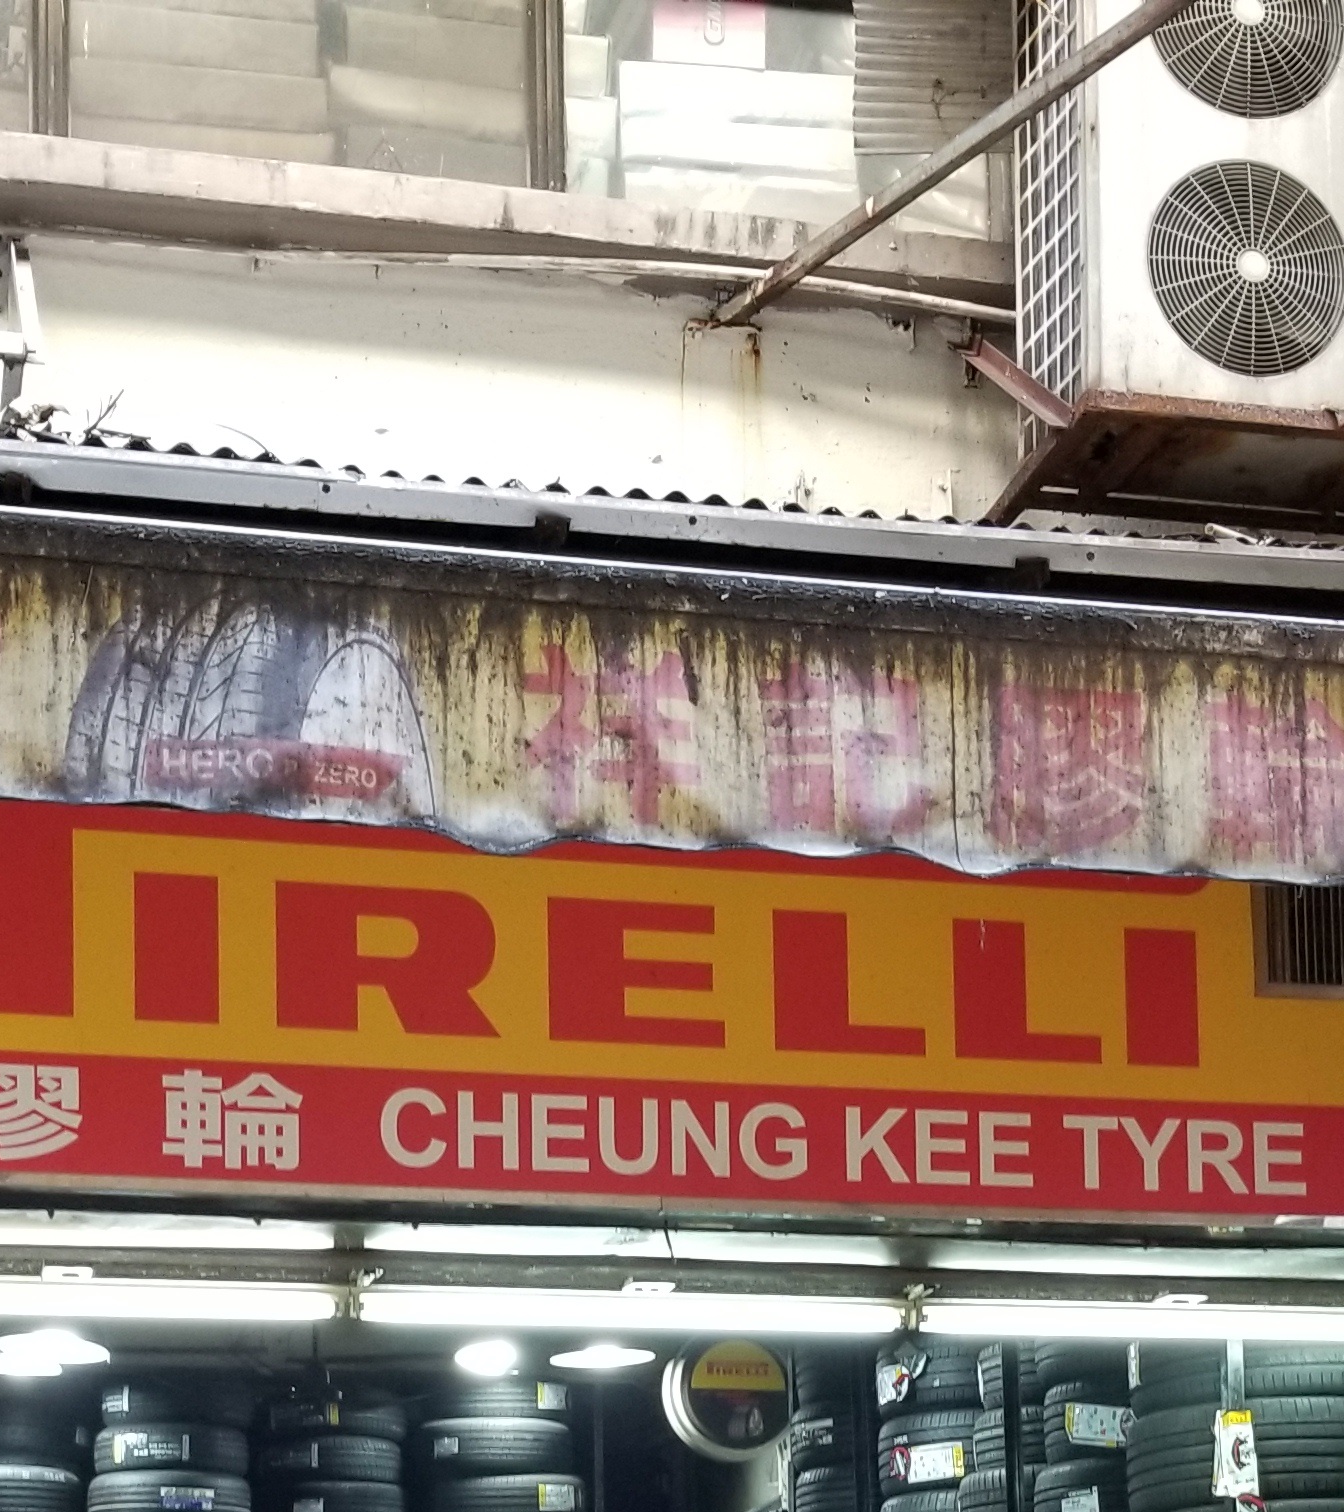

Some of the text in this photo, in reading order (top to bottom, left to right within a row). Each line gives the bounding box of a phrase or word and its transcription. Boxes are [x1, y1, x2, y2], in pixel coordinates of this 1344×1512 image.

[314, 761, 377, 789] ZERO
[379, 1087, 809, 1182] CHEUNG
[845, 1105, 1035, 1187] KEE
[1062, 1113, 1307, 1196] TYRE
